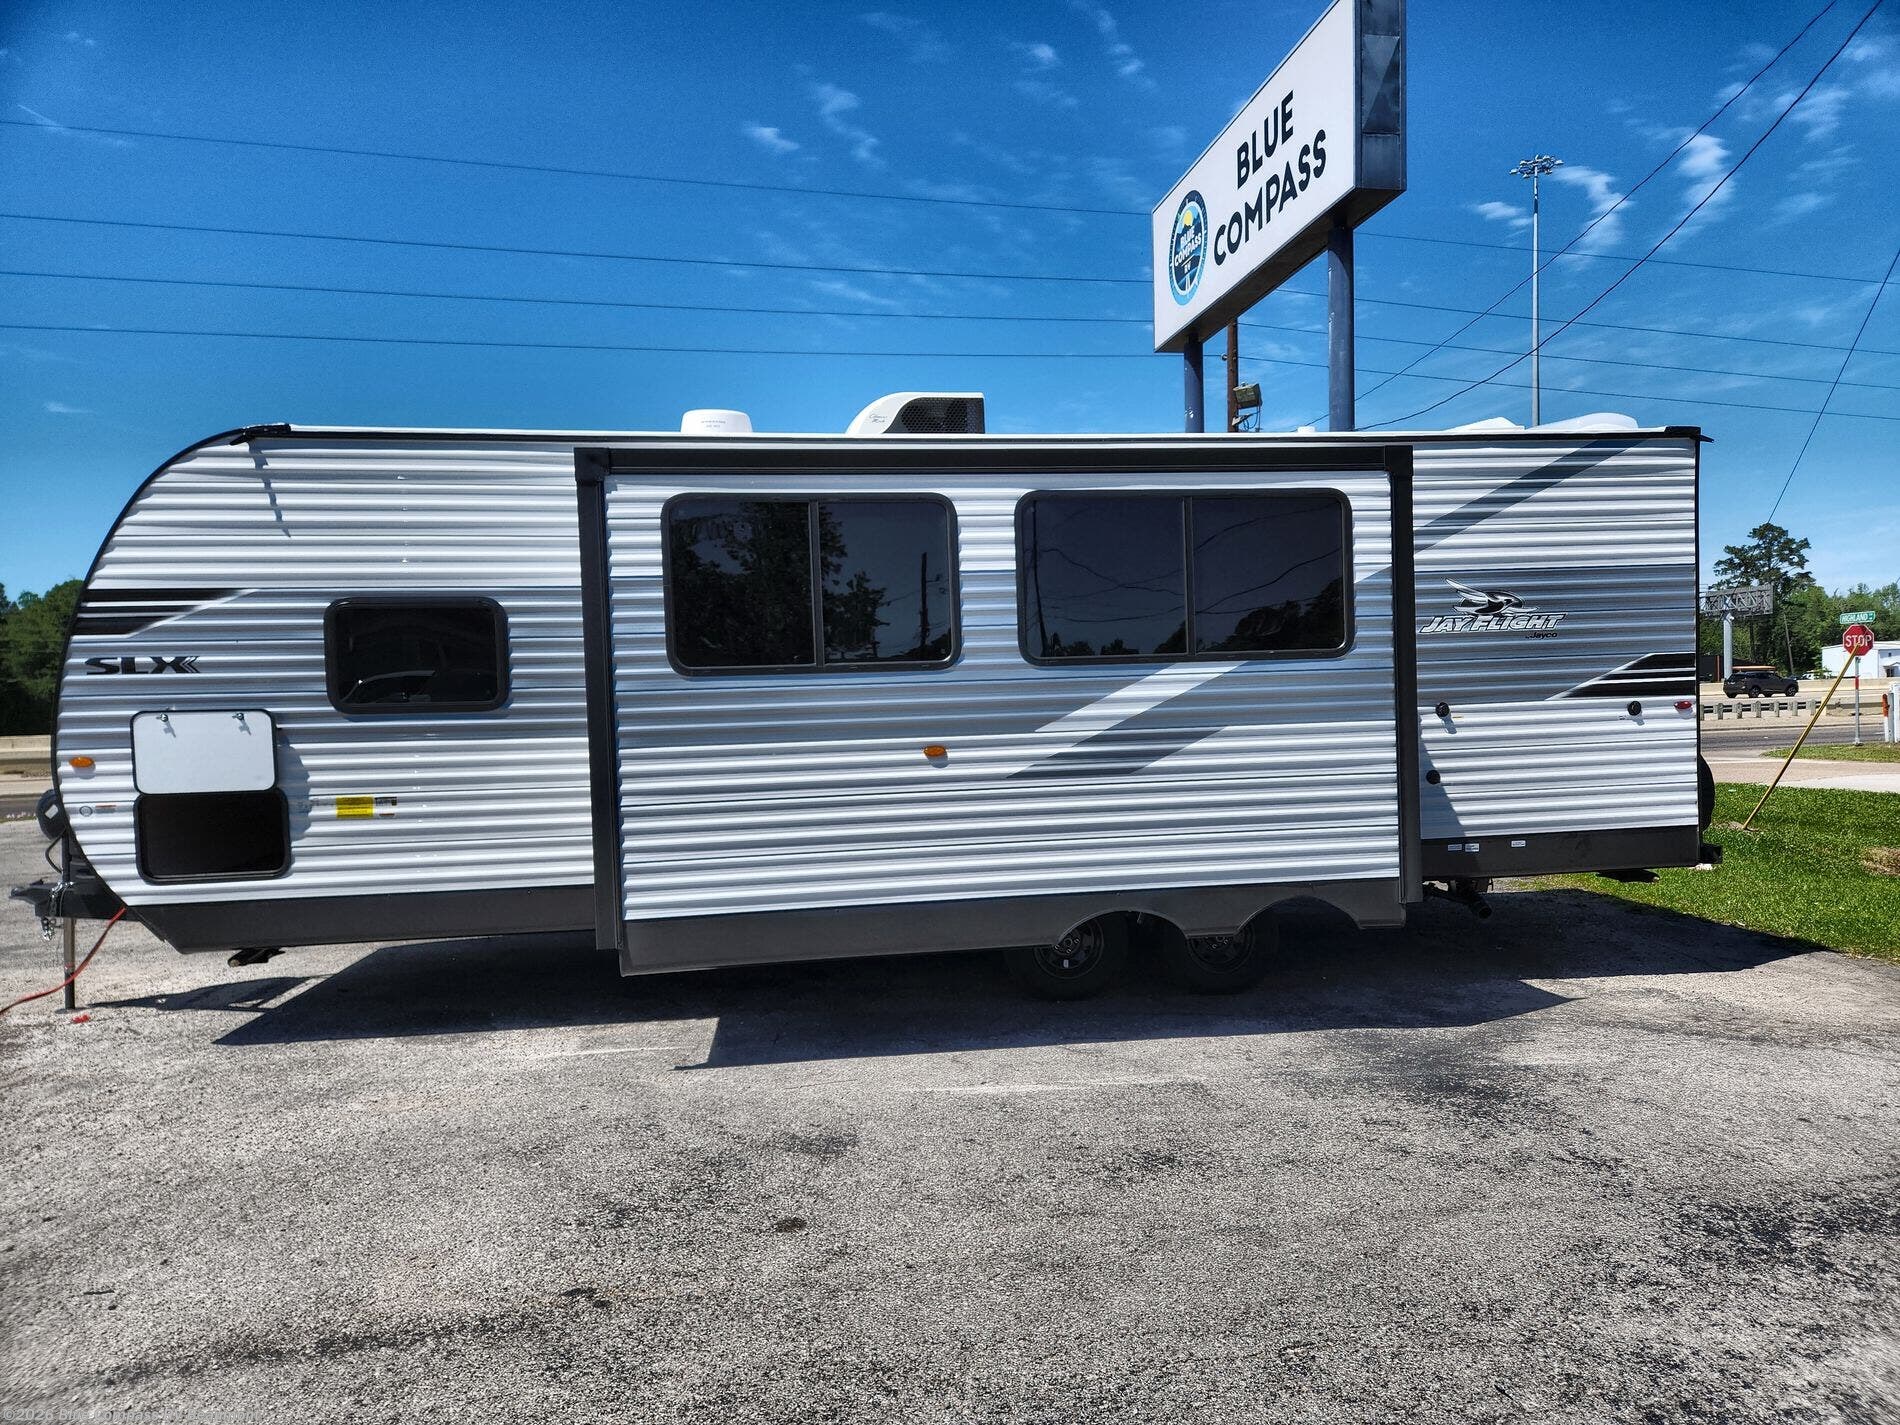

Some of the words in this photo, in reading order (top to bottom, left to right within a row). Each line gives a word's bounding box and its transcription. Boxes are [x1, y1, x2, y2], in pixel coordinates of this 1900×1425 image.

[1237, 90, 1294, 190] BLUE
[1214, 129, 1327, 266] COMPASS
[1180, 225, 1195, 248] BLUE
[1174, 232, 1203, 268] COMPASS
[1419, 615, 1470, 634] JAY
[1470, 613, 1567, 632] FLIGHT
[1845, 634, 1872, 648] STOP
[84, 655, 201, 676] SLX
